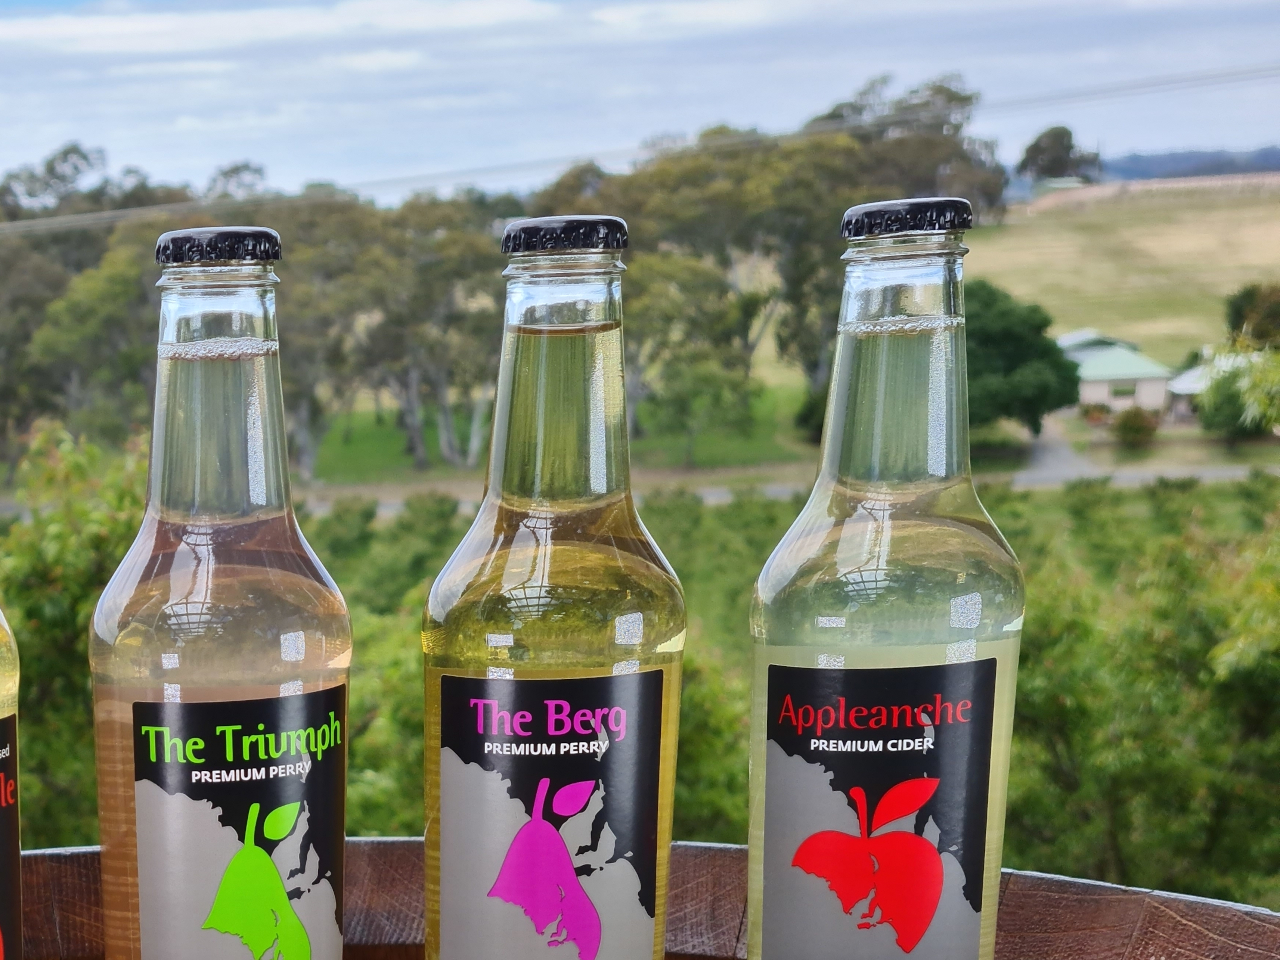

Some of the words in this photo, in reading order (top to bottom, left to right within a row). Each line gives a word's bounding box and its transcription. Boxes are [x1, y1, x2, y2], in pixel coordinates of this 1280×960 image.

[470, 698, 532, 736] The
[543, 699, 627, 742] Berg
[778, 693, 972, 736] Appleanche
[141, 725, 205, 763] The
[215, 711, 342, 762] Triumph
[484, 742, 556, 755] PREMIUM
[560, 740, 609, 754] PERRY
[810, 738, 883, 752] PREMIUM
[887, 737, 934, 751] CIDER
[191, 767, 266, 783] PREMIUM
[269, 761, 312, 778] PERRY
